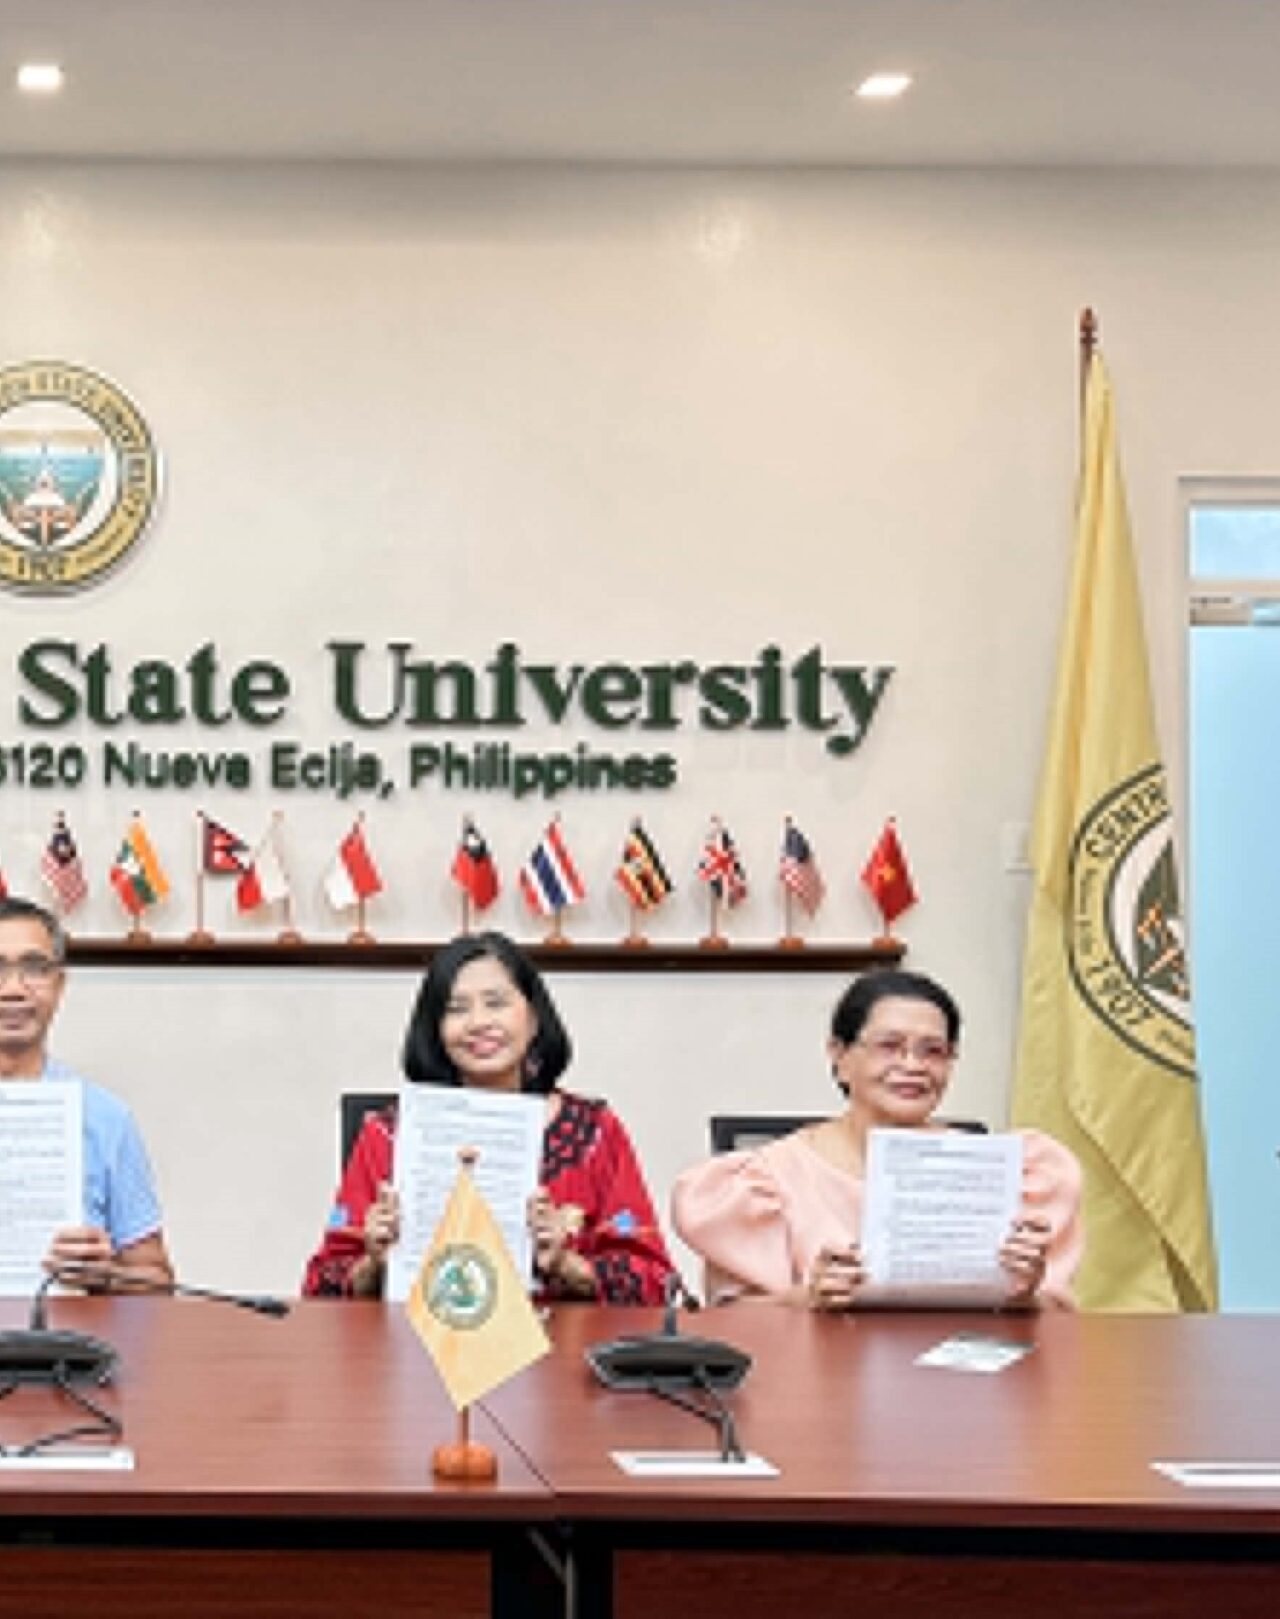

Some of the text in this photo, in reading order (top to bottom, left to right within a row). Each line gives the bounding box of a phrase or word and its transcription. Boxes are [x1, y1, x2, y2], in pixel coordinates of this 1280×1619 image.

[17, 640, 291, 730] State
[326, 641, 896, 756] University
[102, 740, 252, 789] Nueva
[409, 741, 679, 800] Philippines
